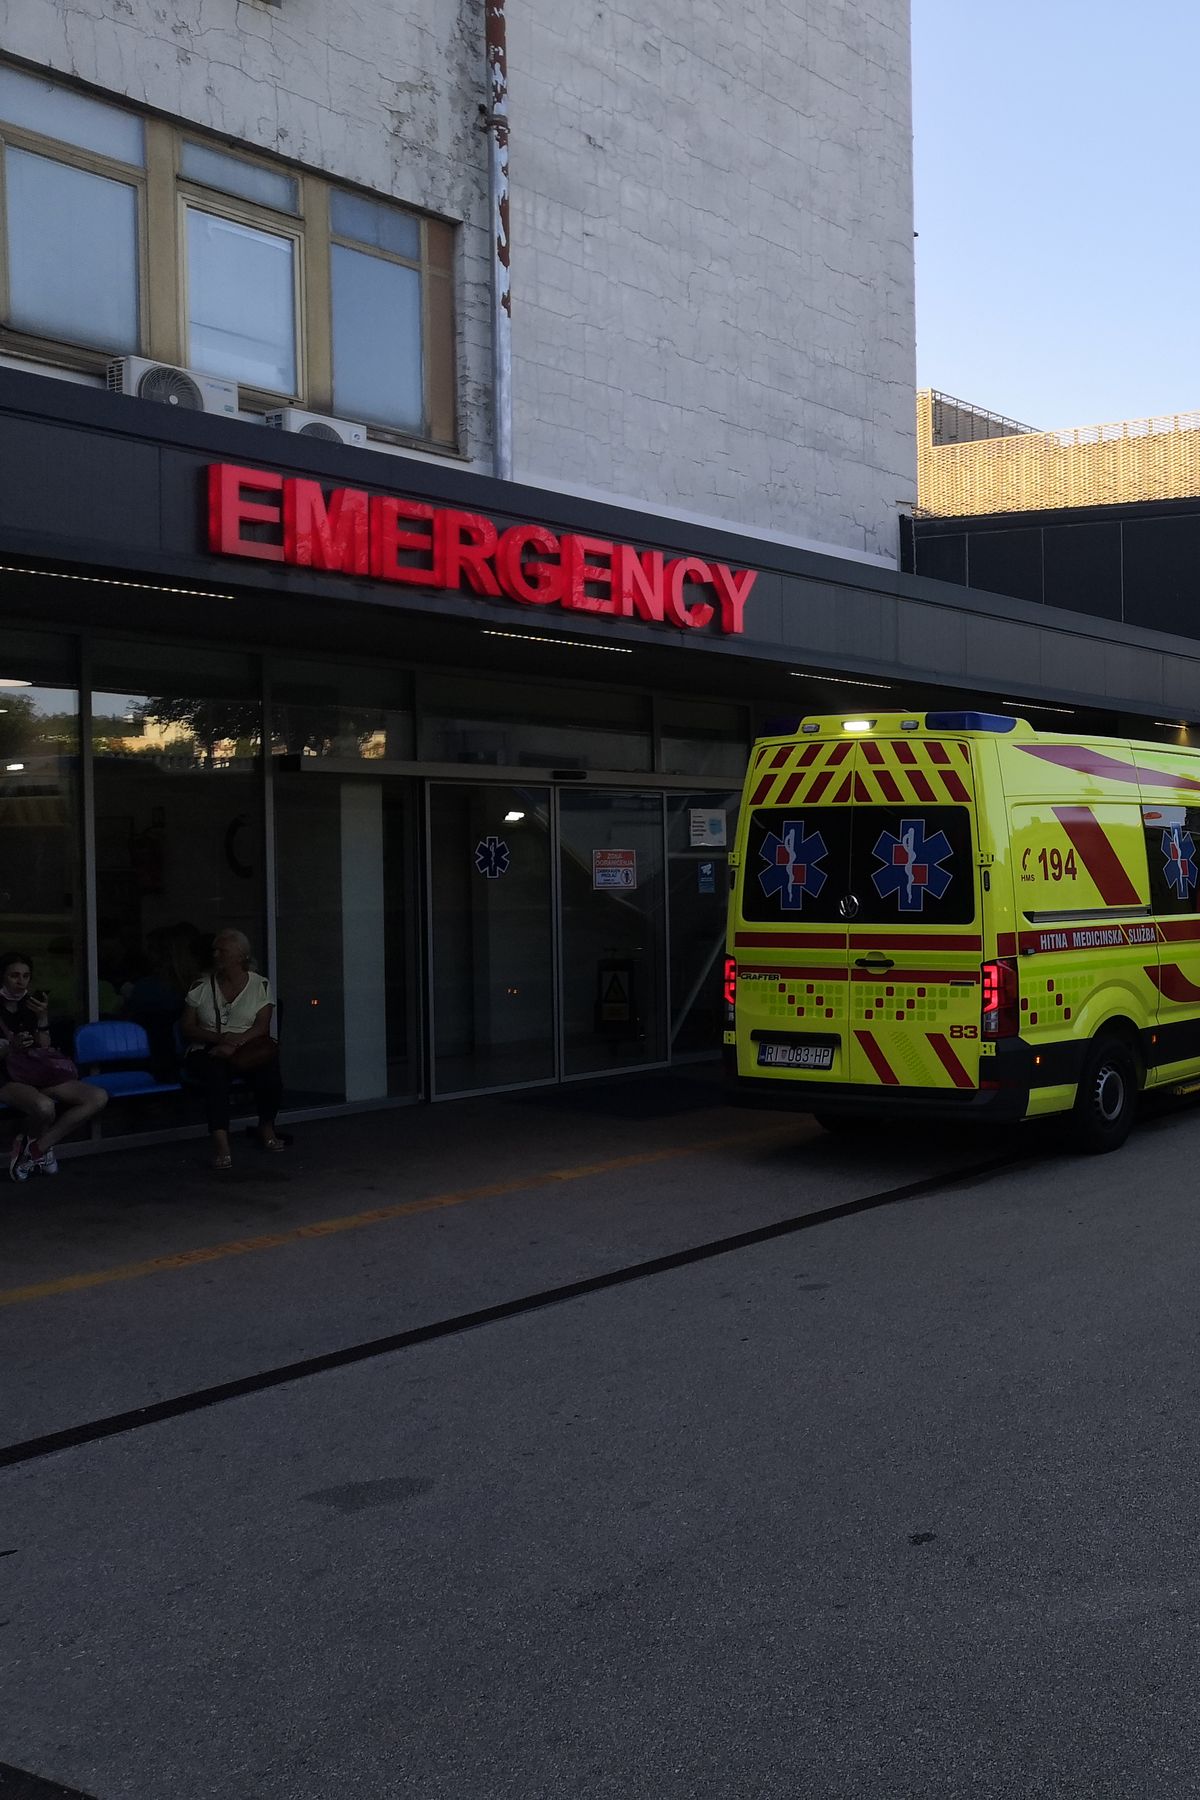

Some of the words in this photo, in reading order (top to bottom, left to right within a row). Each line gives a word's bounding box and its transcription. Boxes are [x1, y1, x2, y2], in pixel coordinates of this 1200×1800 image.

[208, 463, 758, 634] EMERGENCY
[1038, 847, 1077, 881] 194
[1021, 874, 1036, 882] HMS
[1039, 932, 1069, 950] HITNA
[1072, 929, 1124, 948] MEDICINSKA
[1128, 924, 1156, 943] SLUŽBA
[740, 973, 780, 981] CRAFTER
[950, 1024, 978, 1039] 83
[766, 1046, 779, 1061] RI
[788, 1047, 830, 1063] 083-HP
